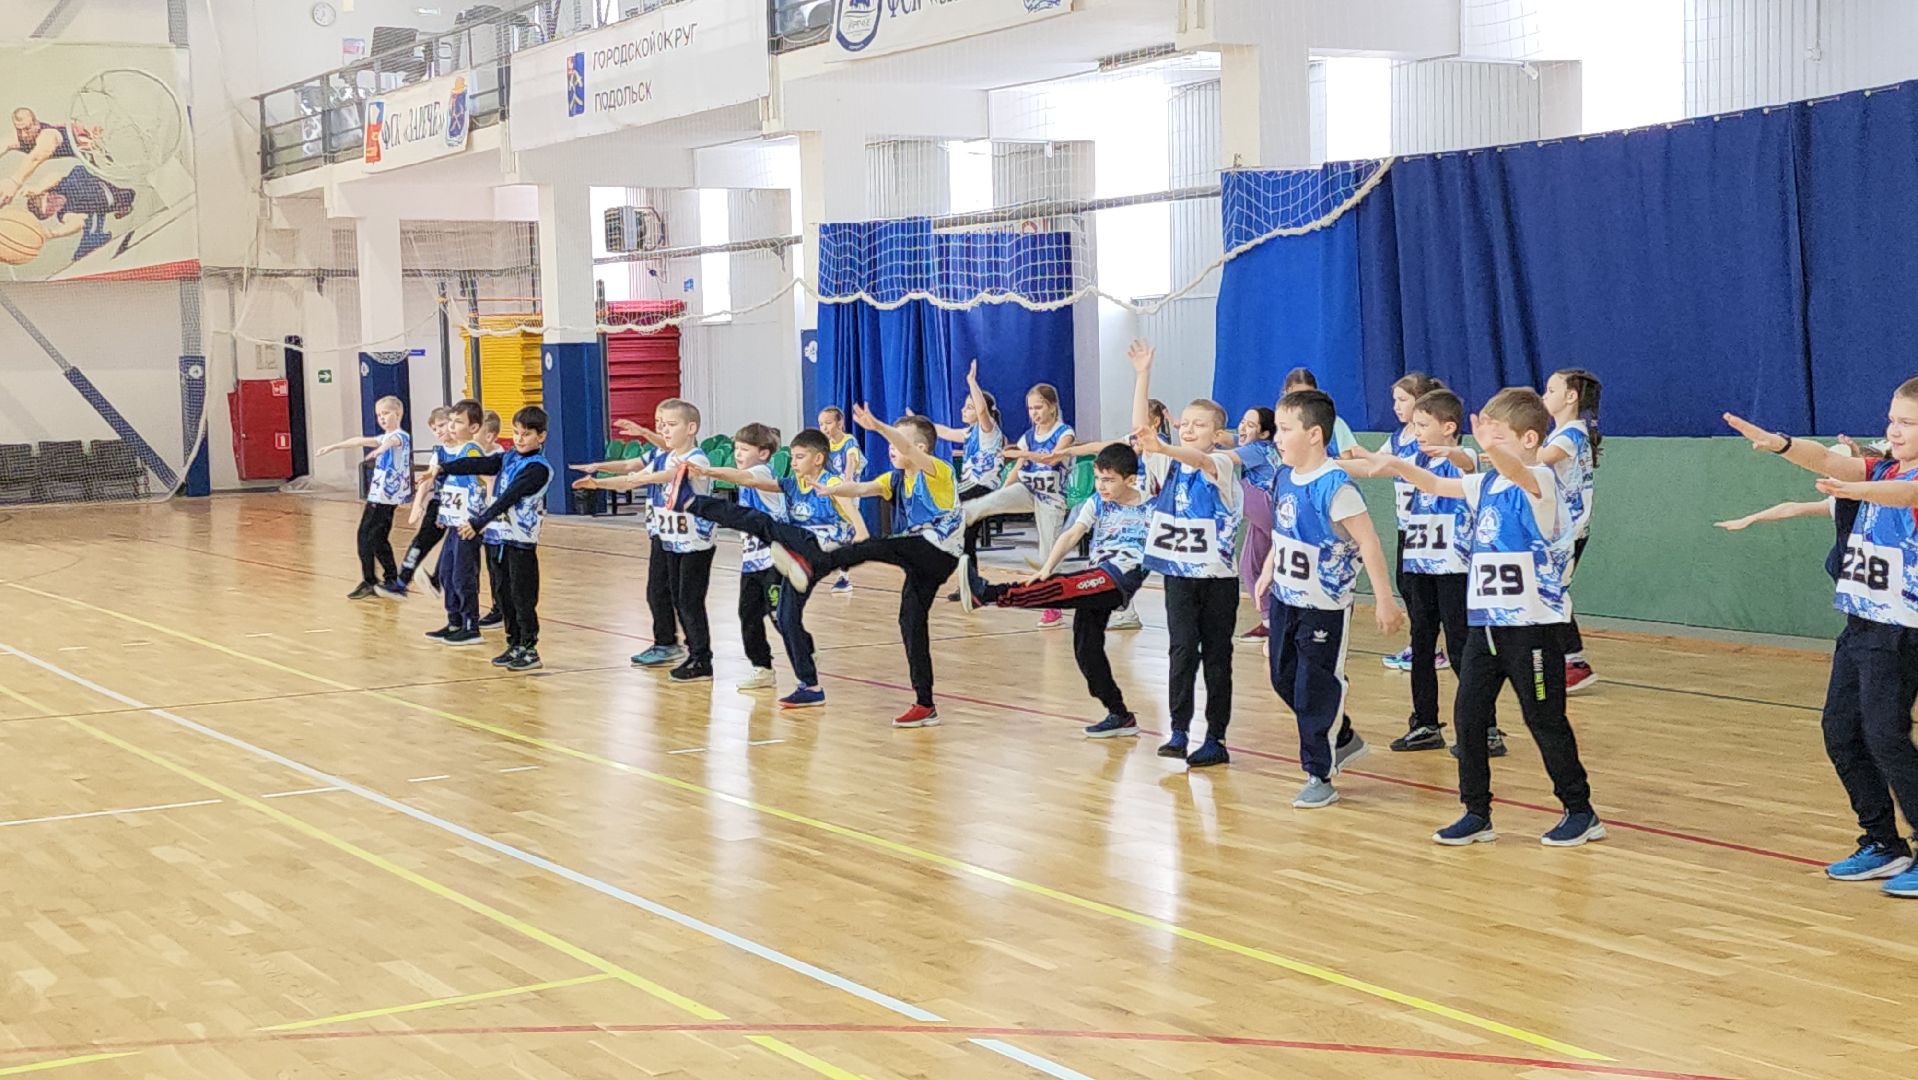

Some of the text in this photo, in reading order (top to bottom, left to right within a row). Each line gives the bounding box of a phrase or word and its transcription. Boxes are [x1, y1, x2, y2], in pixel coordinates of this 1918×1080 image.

[593, 22, 698, 71] ГОРОДСКОЙ ОКРУГ
[594, 80, 653, 113] ПОДОЛЬСК
[1154, 523, 1208, 553] 223
[1476, 564, 1524, 596] 29
[1840, 546, 1889, 591] 228
